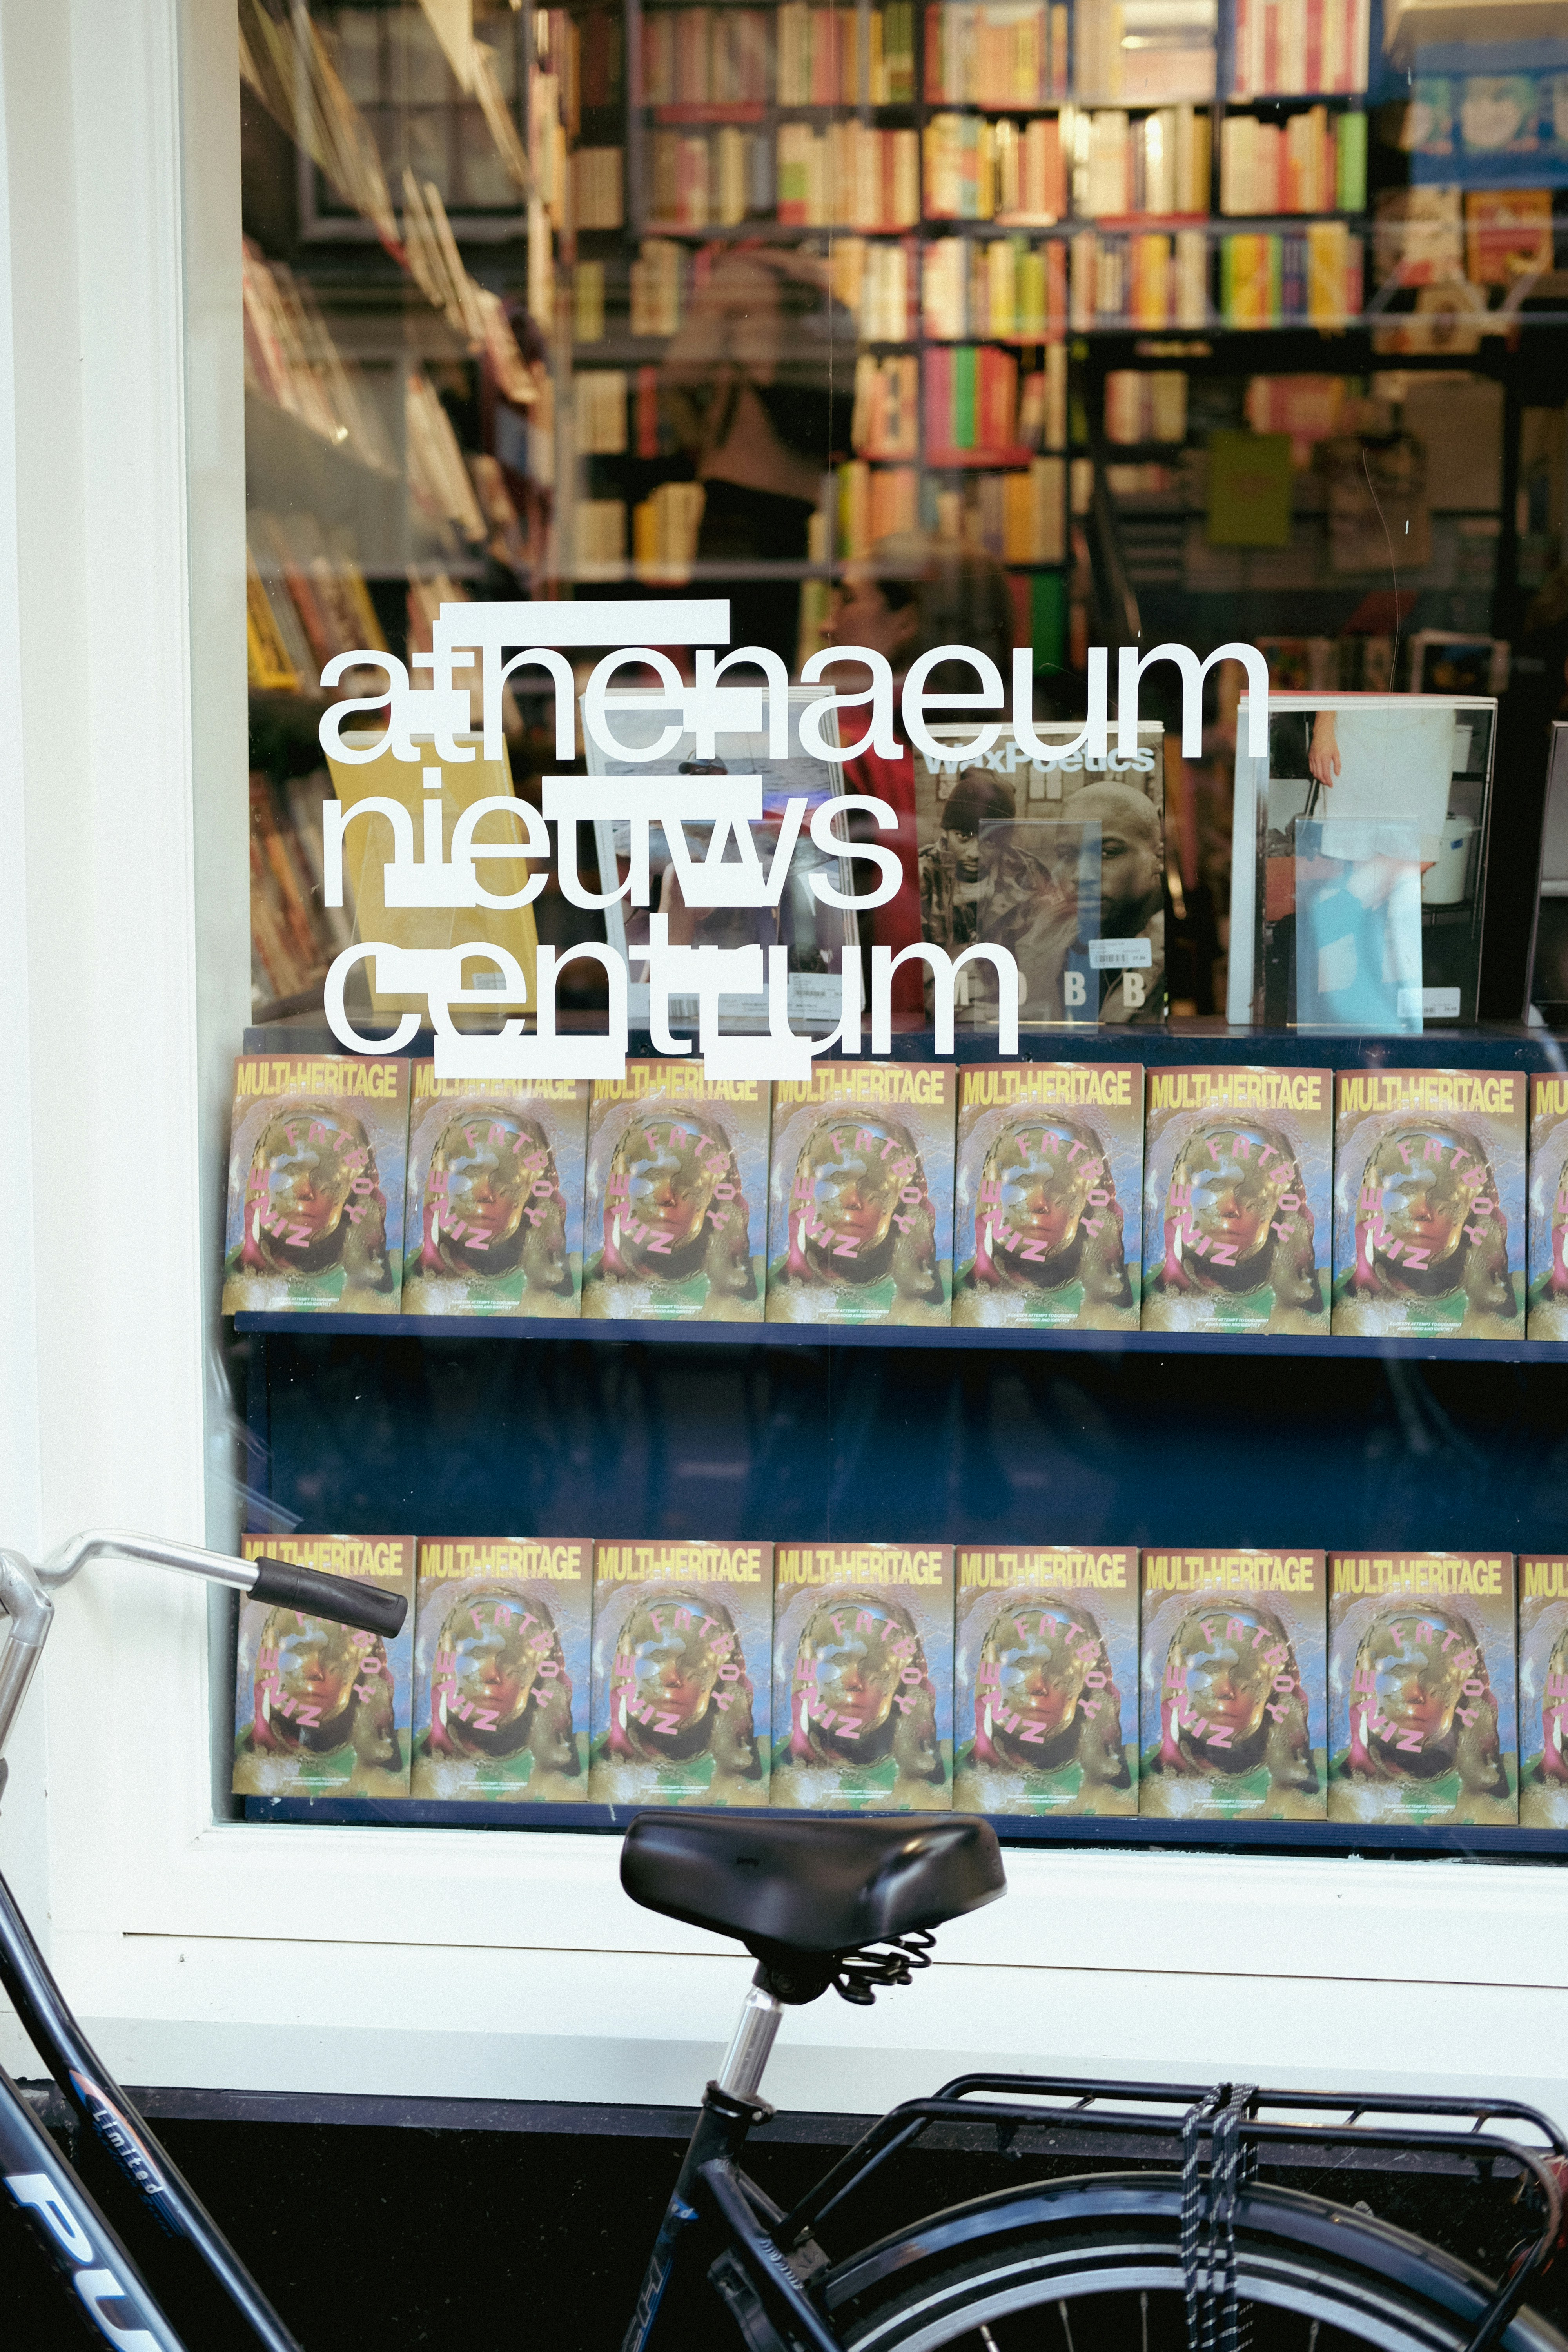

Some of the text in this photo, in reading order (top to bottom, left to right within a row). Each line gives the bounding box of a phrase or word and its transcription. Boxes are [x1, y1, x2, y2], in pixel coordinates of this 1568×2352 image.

[319, 600, 1269, 764] athenaeum
[323, 767, 903, 910] nieuws
[324, 913, 1018, 1080] centrum
[235, 1062, 396, 1097] MULTI-HERITAGE
[963, 1070, 1130, 1105] MULTI-HERITAGE
[1152, 1073, 1321, 1110] MULTI-HERITAGE
[1341, 1076, 1514, 1113] MULTI-HERITAGE
[420, 1544, 579, 1579] MULTI-HERITAGE
[599, 1547, 760, 1582] MULTI-HERITAGE
[778, 1550, 941, 1585] MULTI-HERITAGE
[960, 1553, 1125, 1588] MULTI-HERITAGE
[1146, 1555, 1313, 1592] MULTI-HERITAGE
[1334, 1559, 1502, 1595] MULTI-HERITAGE
[93, 2109, 164, 2194] Limited
